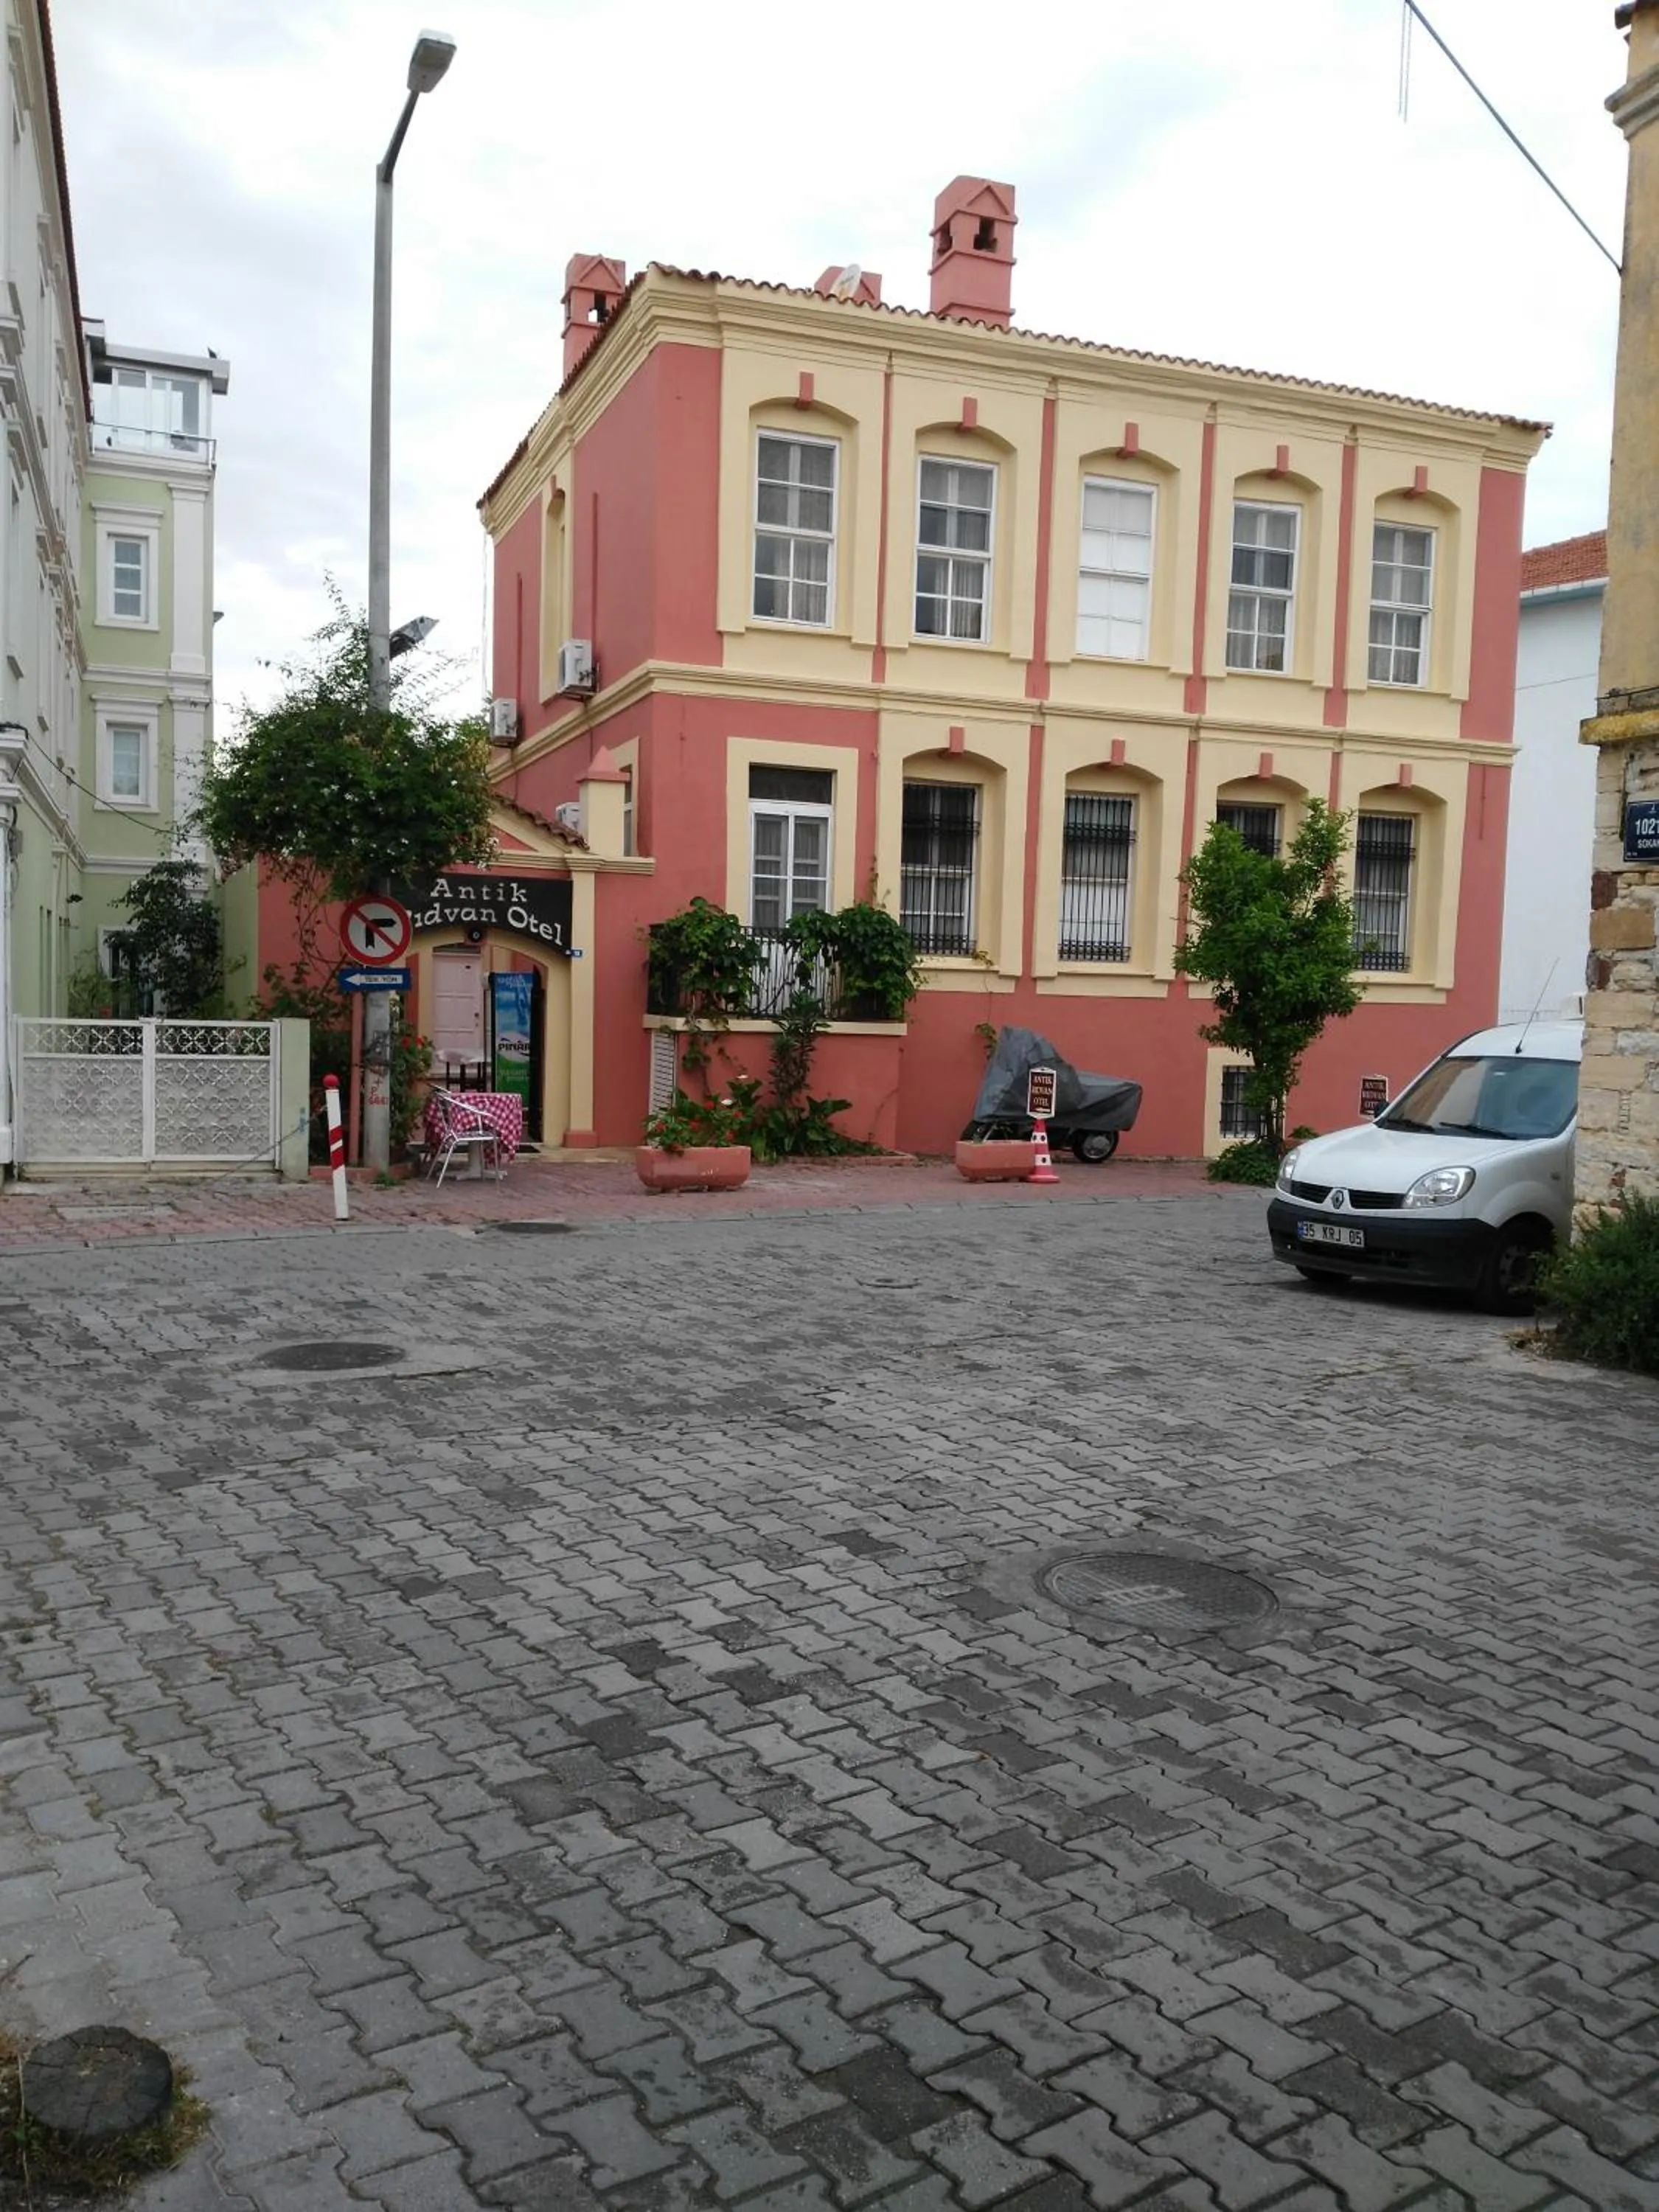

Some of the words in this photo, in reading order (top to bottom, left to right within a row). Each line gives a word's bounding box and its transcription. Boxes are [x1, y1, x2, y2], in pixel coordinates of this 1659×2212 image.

[430, 878, 527, 902] Antik
[406, 902, 498, 928] ıdvan
[507, 905, 563, 946] Otel
[1303, 1223, 1315, 1237] 35
[1322, 1226, 1341, 1242] XRJ
[1349, 1229, 1362, 1245] 05
